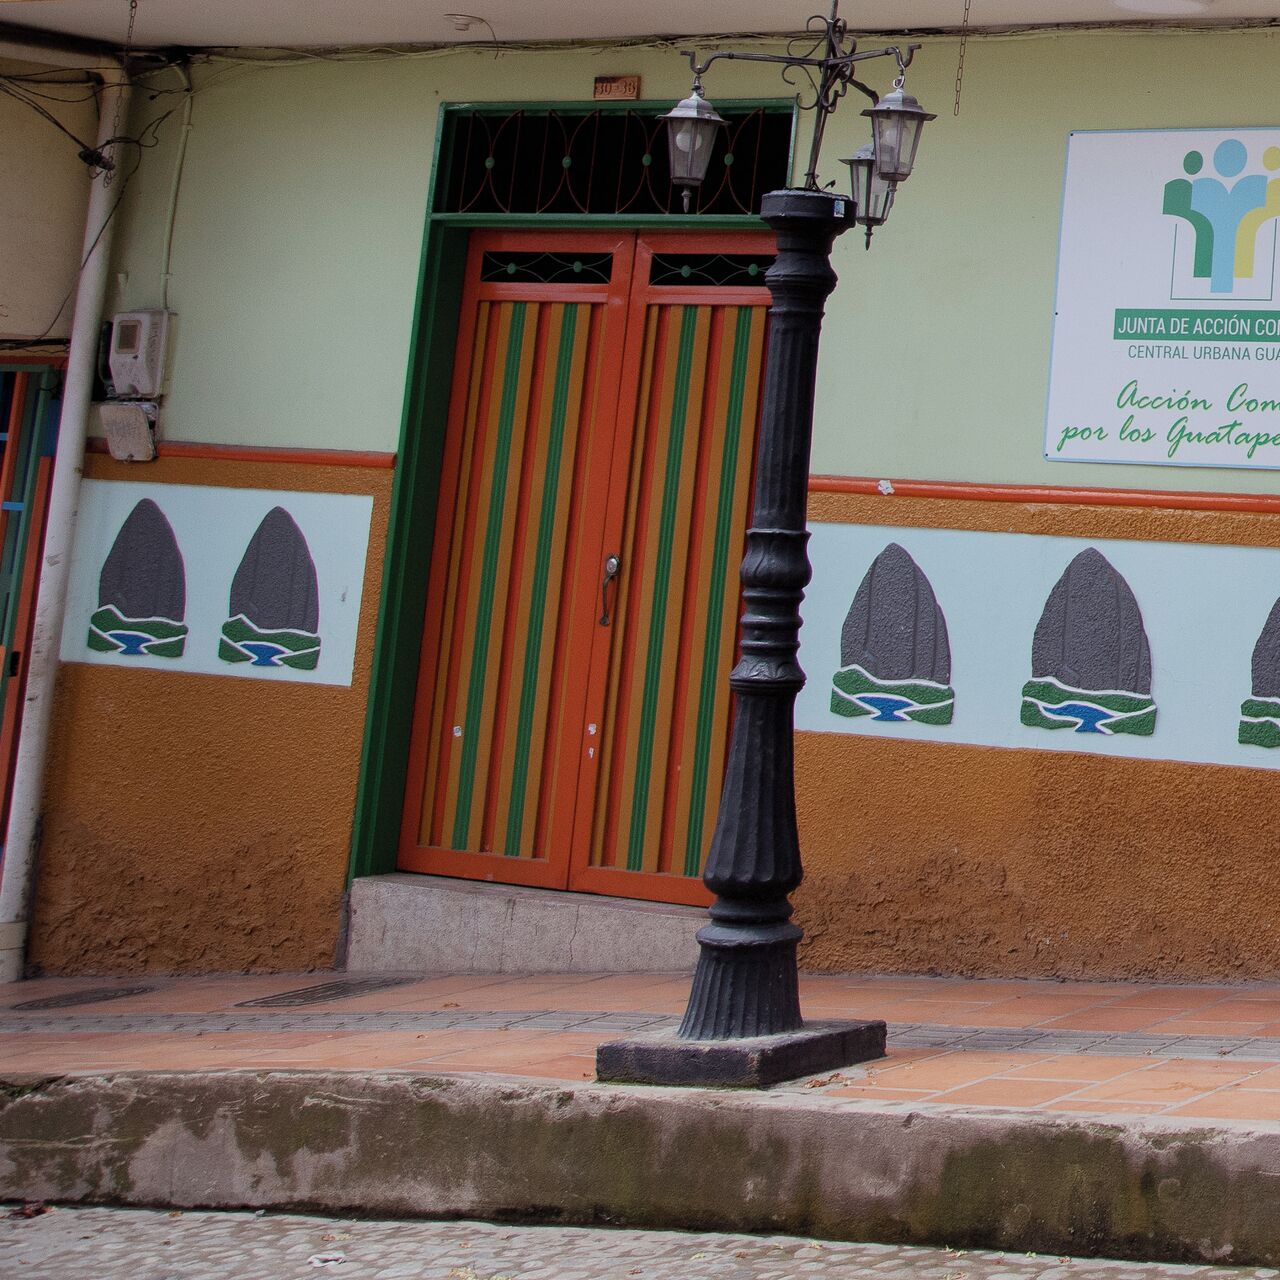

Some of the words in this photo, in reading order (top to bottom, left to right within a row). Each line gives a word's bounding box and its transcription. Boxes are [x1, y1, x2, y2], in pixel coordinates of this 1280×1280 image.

[1118, 317, 1166, 334] JUNTA
[1170, 318, 1190, 335] DE
[1193, 314, 1251, 336] ACCIÓN
[1128, 345, 1189, 359] CENTRAL
[1193, 346, 1251, 361] URBANA
[1116, 379, 1213, 411] Acción
[1056, 421, 1109, 452] por
[1119, 414, 1156, 442] los
